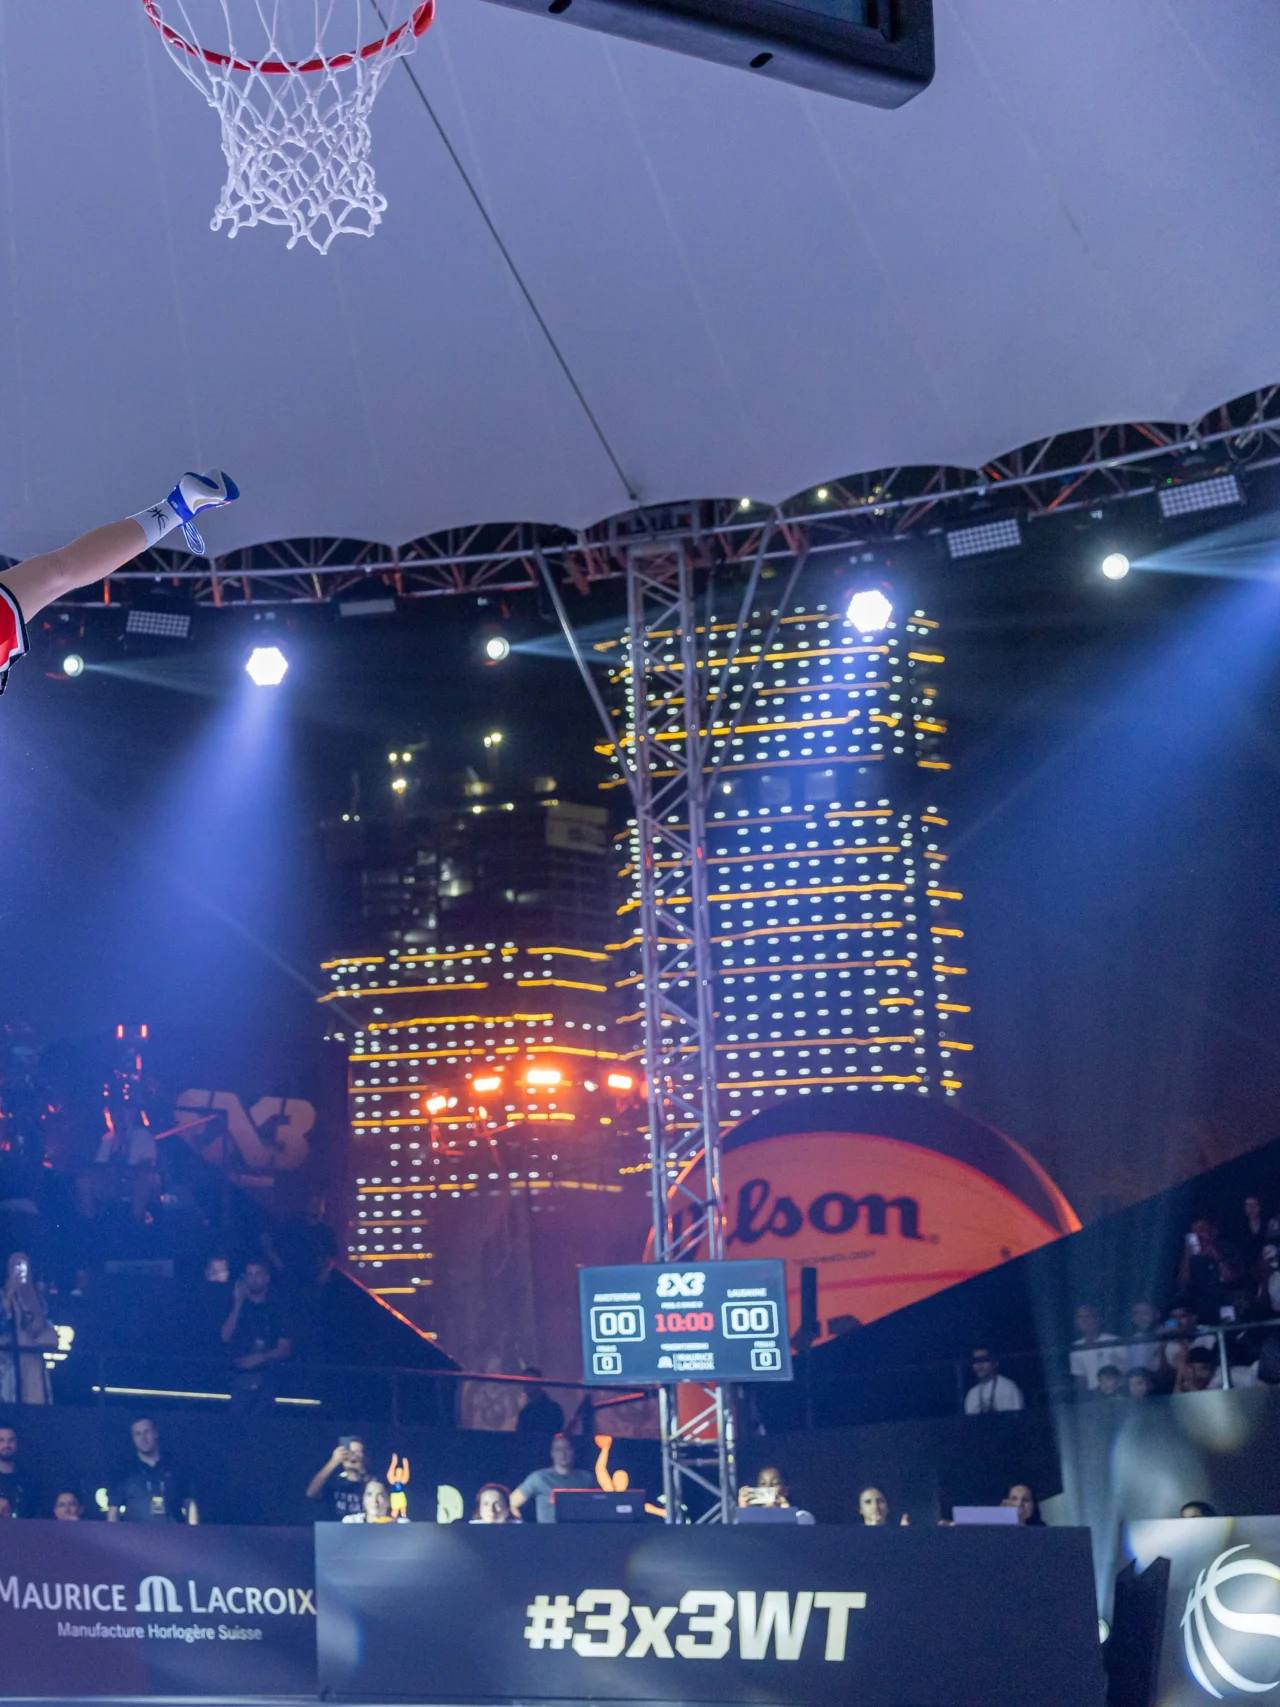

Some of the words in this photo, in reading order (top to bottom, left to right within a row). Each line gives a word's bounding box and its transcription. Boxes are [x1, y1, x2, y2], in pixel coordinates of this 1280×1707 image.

[673, 1178, 926, 1258] lson
[599, 1311, 637, 1336] 00
[655, 1312, 715, 1333] 10:00
[730, 1307, 770, 1332] 00
[188, 1579, 317, 1616] LACROIX
[57, 1621, 145, 1639] Manufacture
[147, 1623, 216, 1644] Horlogère
[218, 1625, 263, 1641] Suisse
[523, 1588, 868, 1662] #3x3WT
